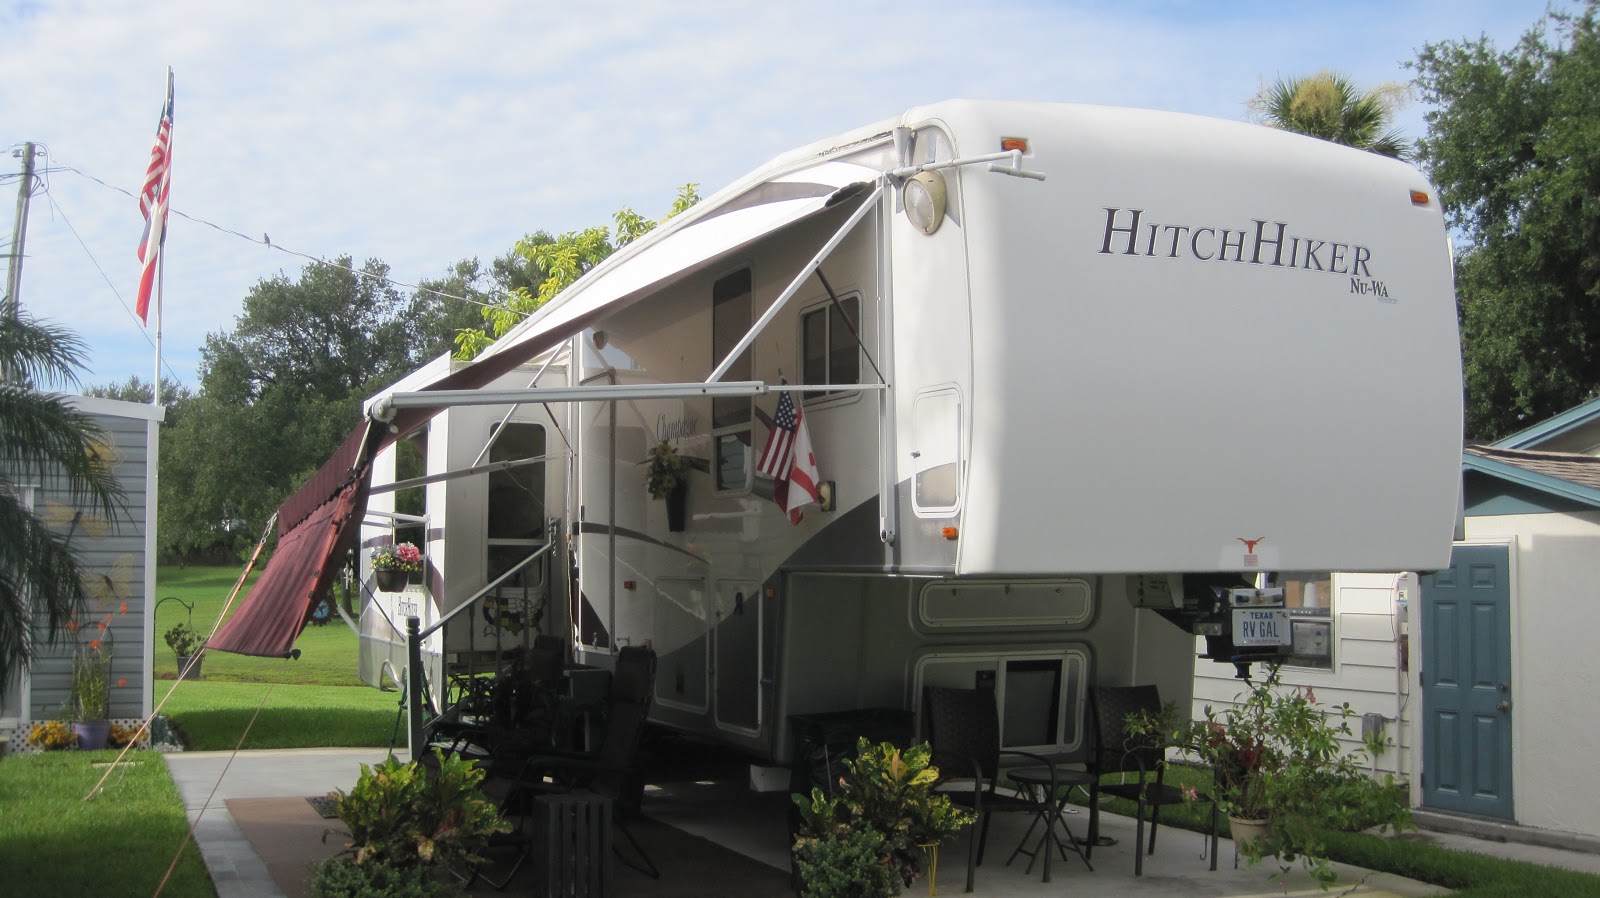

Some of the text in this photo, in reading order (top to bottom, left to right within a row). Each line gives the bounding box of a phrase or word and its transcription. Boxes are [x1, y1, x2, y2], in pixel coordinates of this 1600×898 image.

[1250, 611, 1274, 620] TEXAS
[1243, 621, 1280, 638] RV GAL
